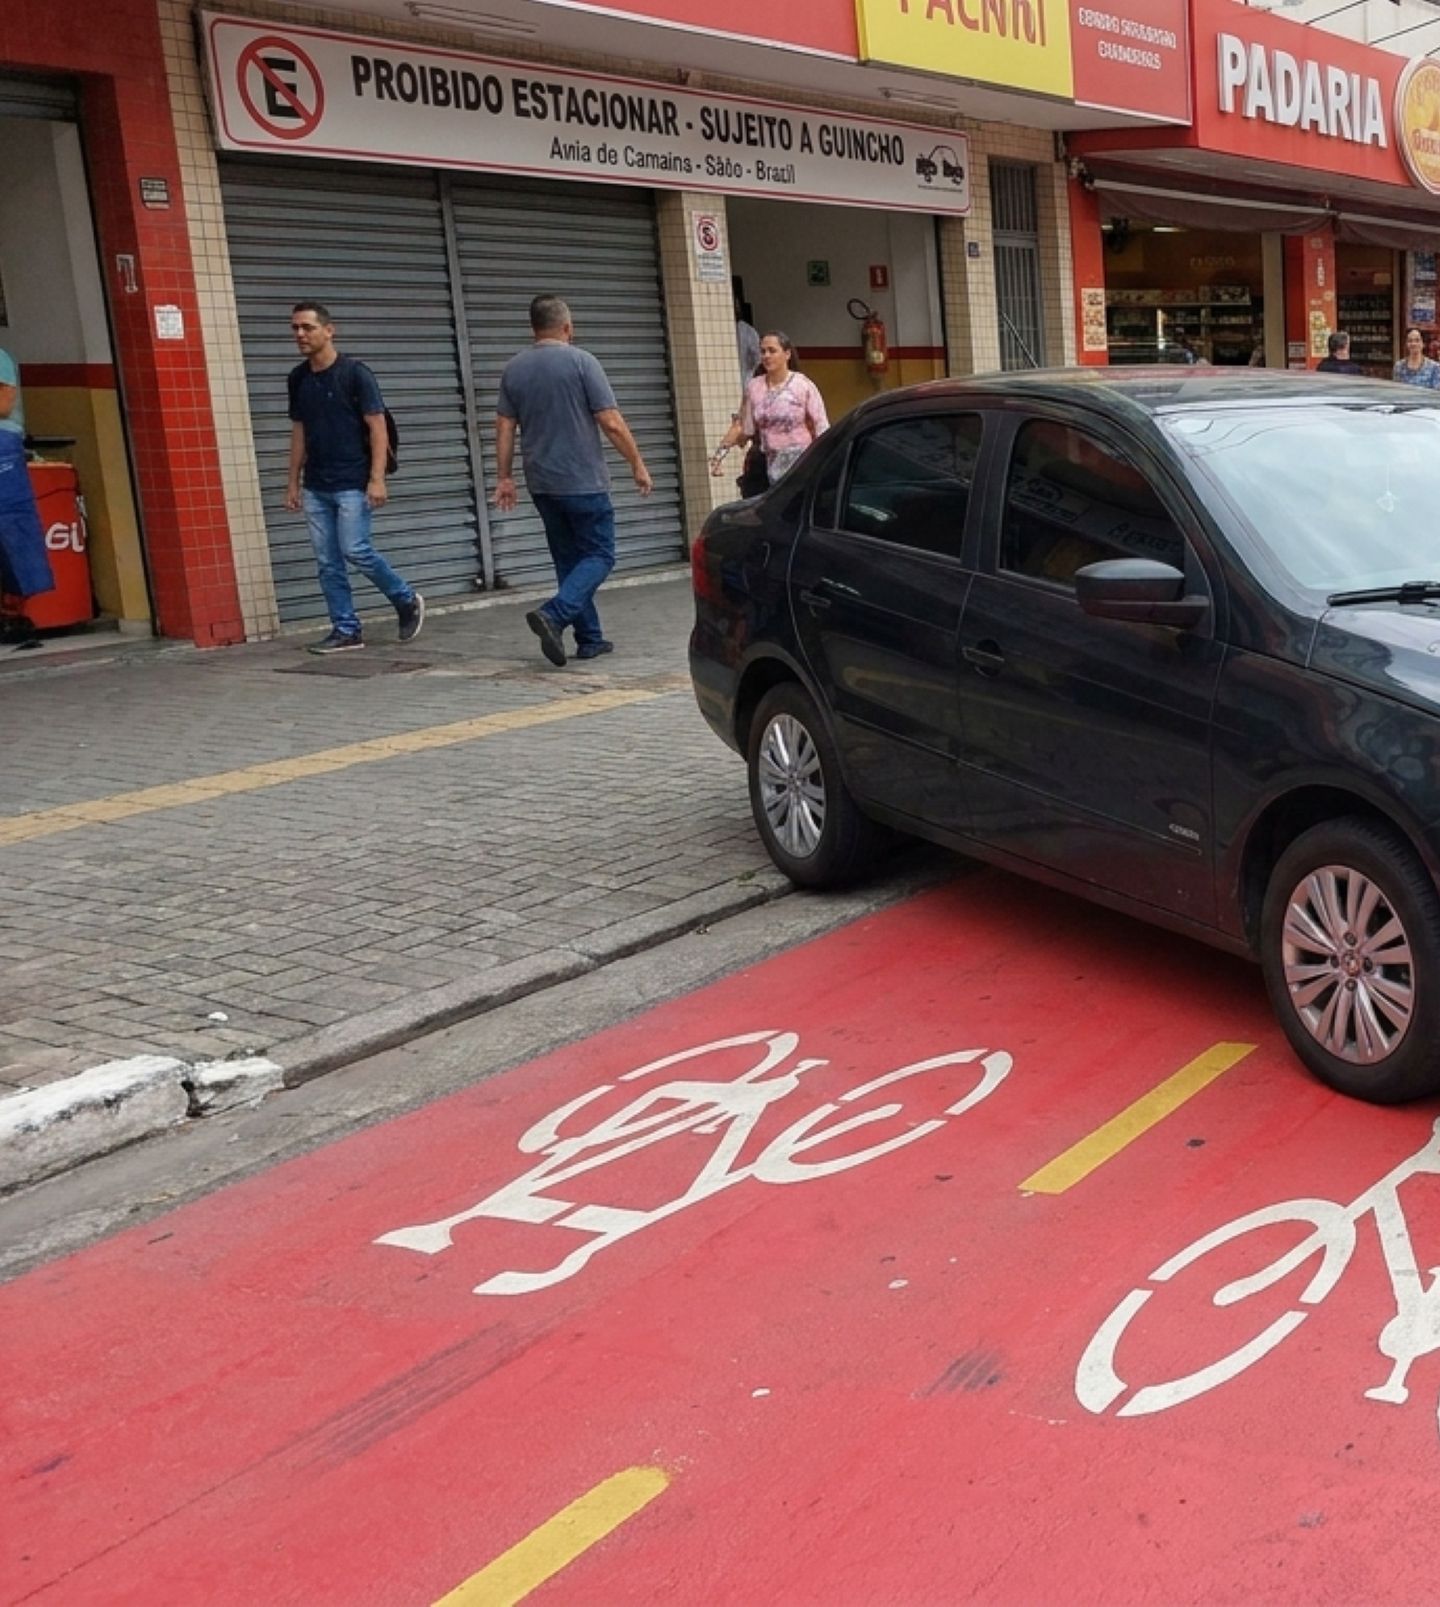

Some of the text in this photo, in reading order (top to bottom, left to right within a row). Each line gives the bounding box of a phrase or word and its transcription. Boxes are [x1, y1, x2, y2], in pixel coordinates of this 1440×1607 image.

[351, 55, 503, 114] PROIBIDO
[512, 78, 680, 136] ESTACIONAR
[700, 106, 793, 151] SUJEITO
[800, 121, 815, 154] A
[818, 124, 905, 165] GUINCHO
[1217, 32, 1388, 148] PADARIA
[597, 142, 618, 165] de
[624, 145, 694, 174] Camains
